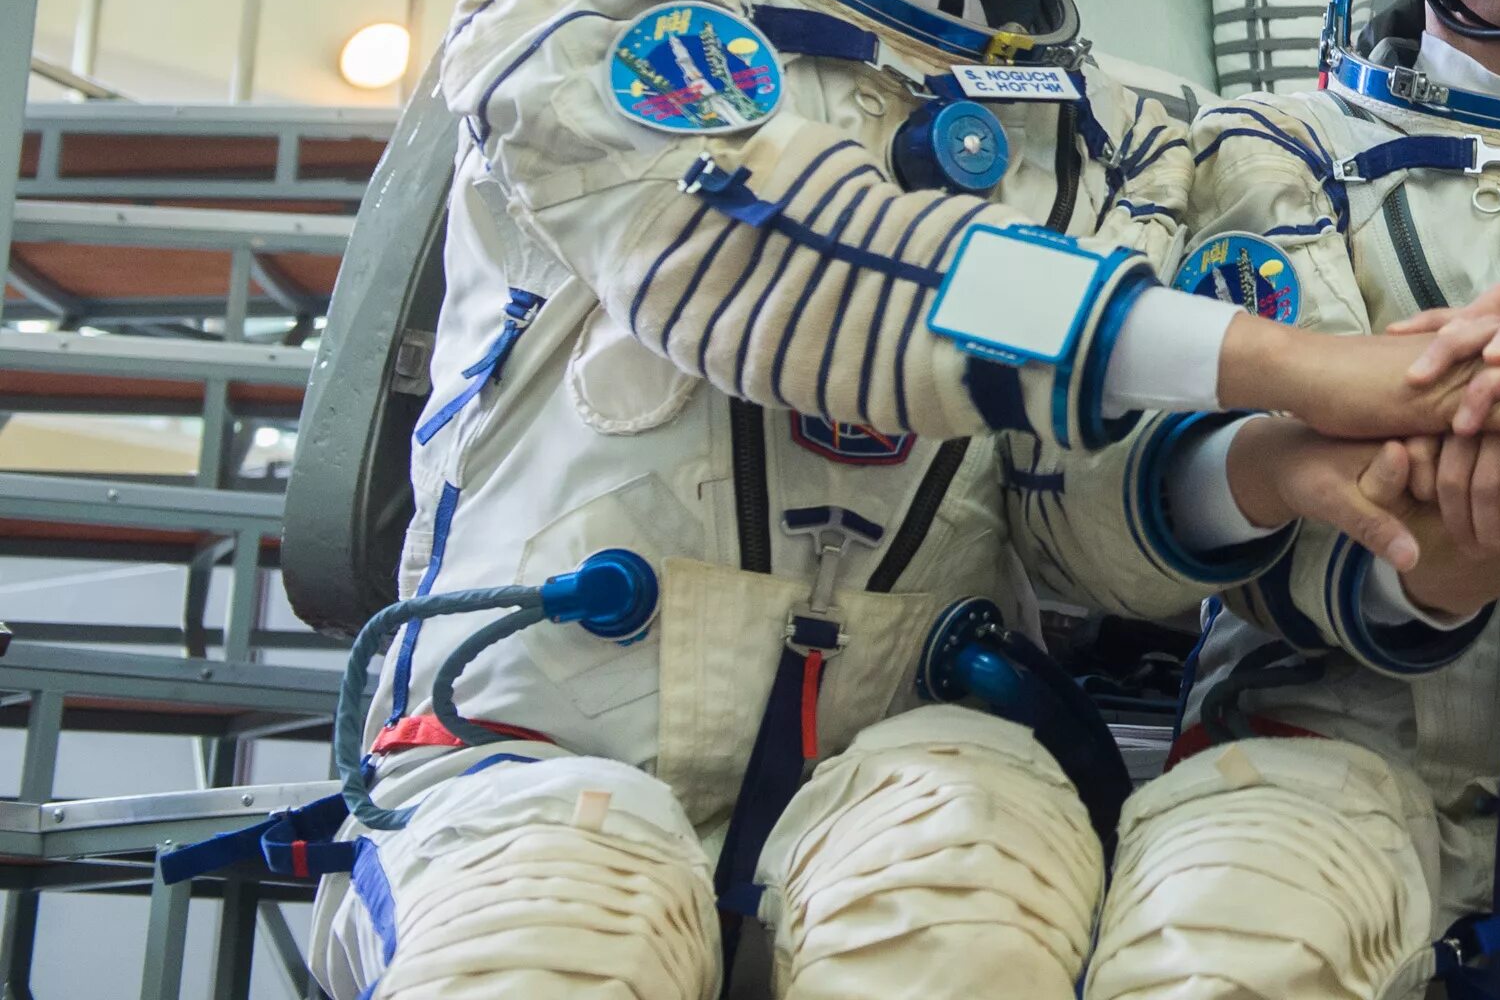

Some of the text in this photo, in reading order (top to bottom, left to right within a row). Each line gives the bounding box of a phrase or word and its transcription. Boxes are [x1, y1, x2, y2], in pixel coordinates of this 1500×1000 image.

[964, 69, 1059, 82] S. NOGUCHI
[975, 82, 1065, 93] С. НОГУЧИ
